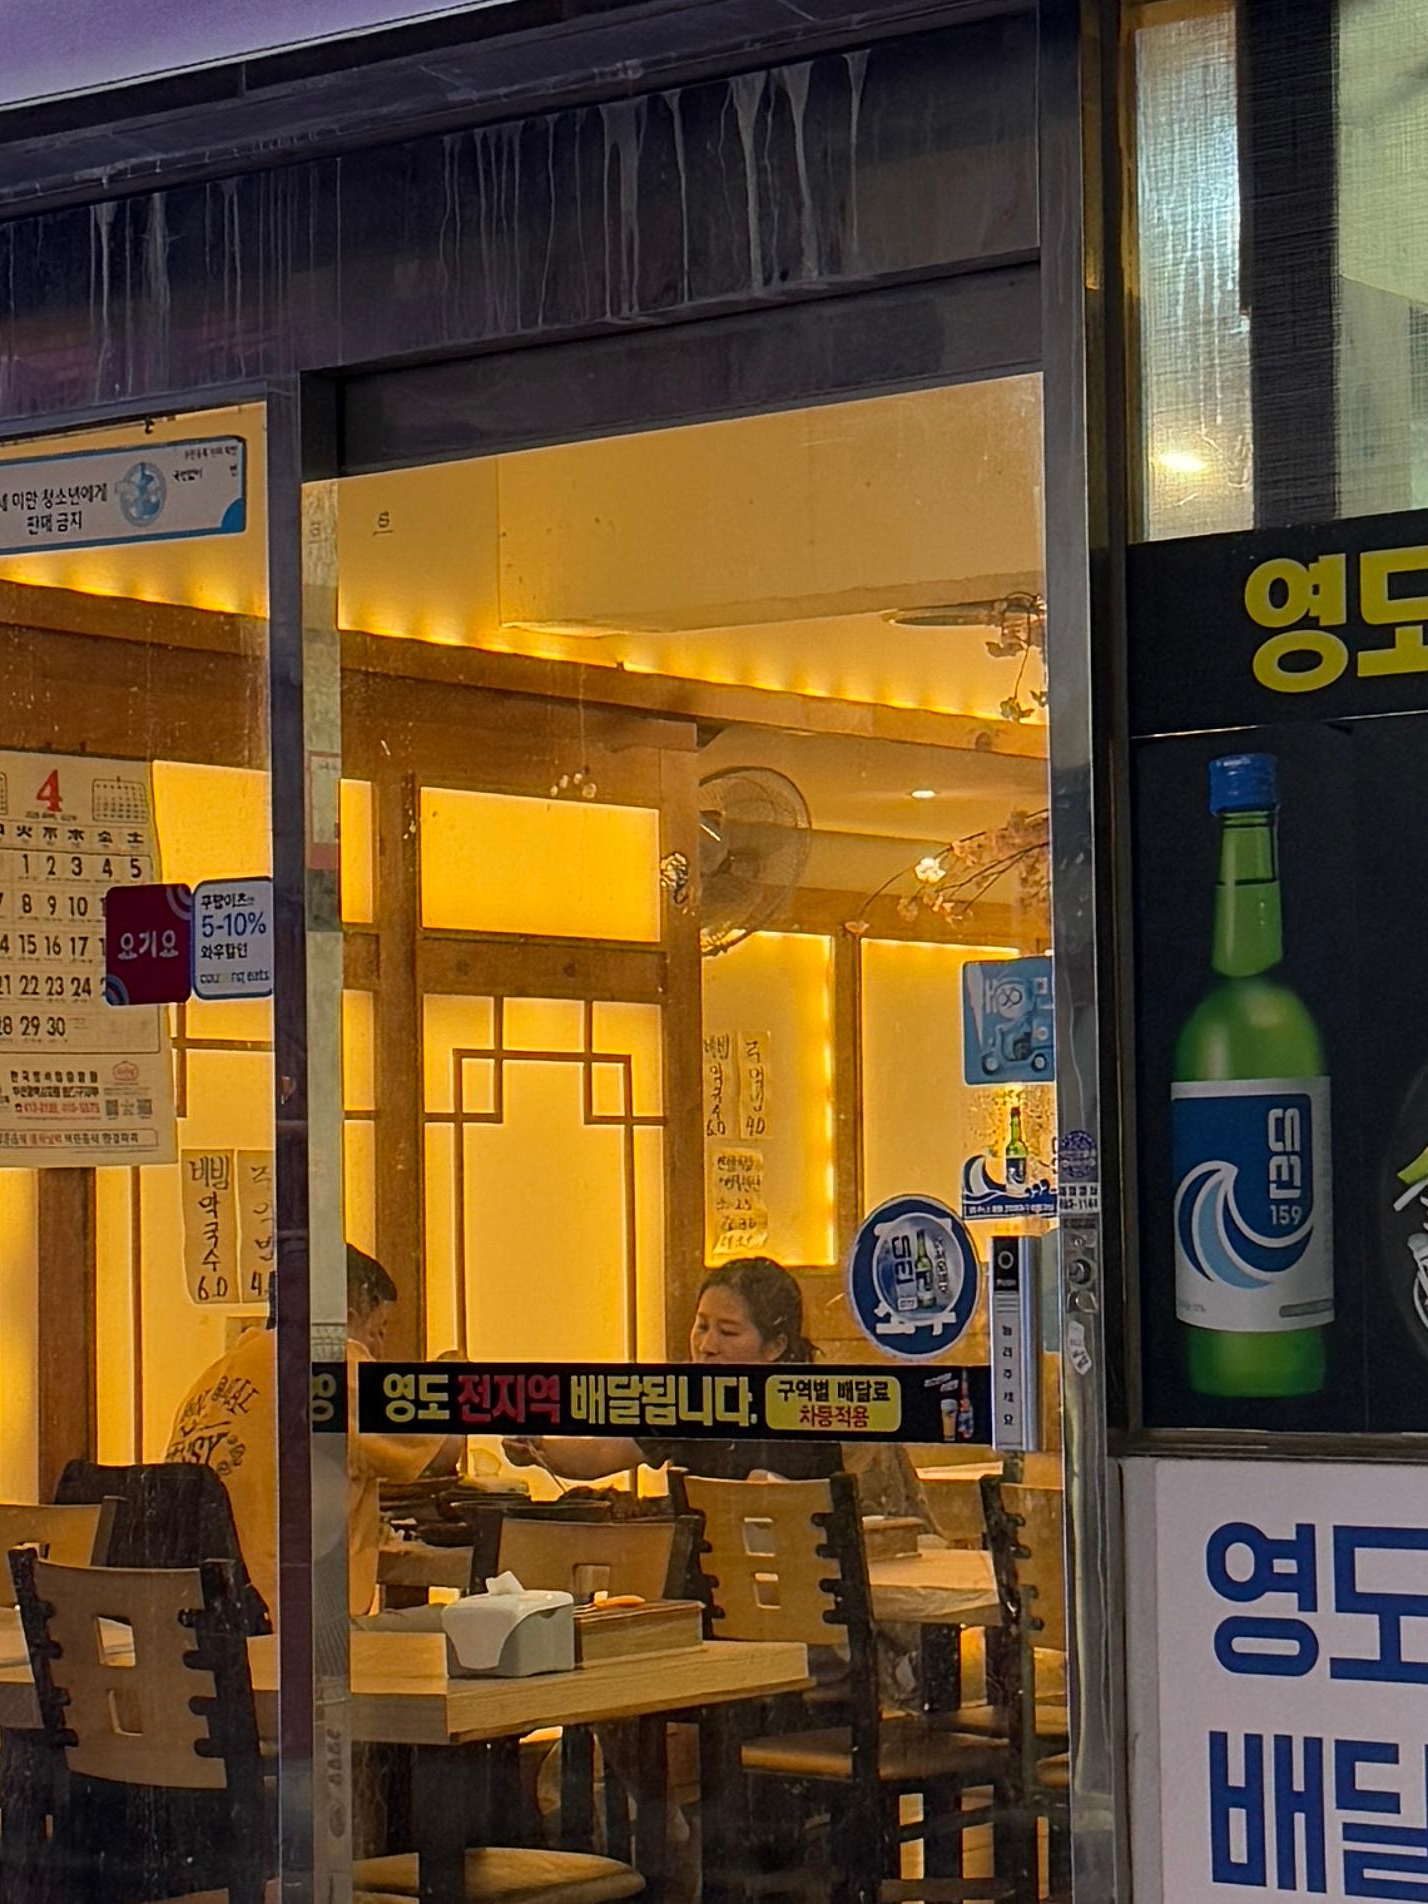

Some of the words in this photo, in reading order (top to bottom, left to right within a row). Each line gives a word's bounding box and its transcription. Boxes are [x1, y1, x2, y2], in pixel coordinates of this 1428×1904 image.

[56, 511, 83, 532] 금지
[35, 768, 64, 813] 4
[21, 853, 30, 875] 1
[45, 855, 57, 877] 2
[70, 855, 83, 877] 3
[101, 857, 114, 879] 4
[129, 858, 143, 879] 5
[21, 893, 33, 914] 8
[46, 895, 57, 916] 9
[68, 896, 89, 917] 10
[202, 911, 267, 938] 5-10%
[18, 933, 38, 955] 15
[44, 935, 62, 957] 16
[70, 936, 89, 957] 17
[117, 928, 179, 961] 요기요
[19, 974, 39, 996] 22
[45, 975, 65, 997] 23
[70, 975, 92, 997] 24
[19, 1016, 41, 1036] 29
[46, 1016, 66, 1037] 30
[1269, 1204, 1303, 1226] 159
[383, 1372, 450, 1424] 영도
[458, 1372, 561, 1424] 전지역
[570, 1373, 758, 1427] 배달됩니다.
[776, 1380, 830, 1404] 구역별
[837, 1380, 891, 1404] 배달료
[799, 1405, 870, 1429] 차등적용
